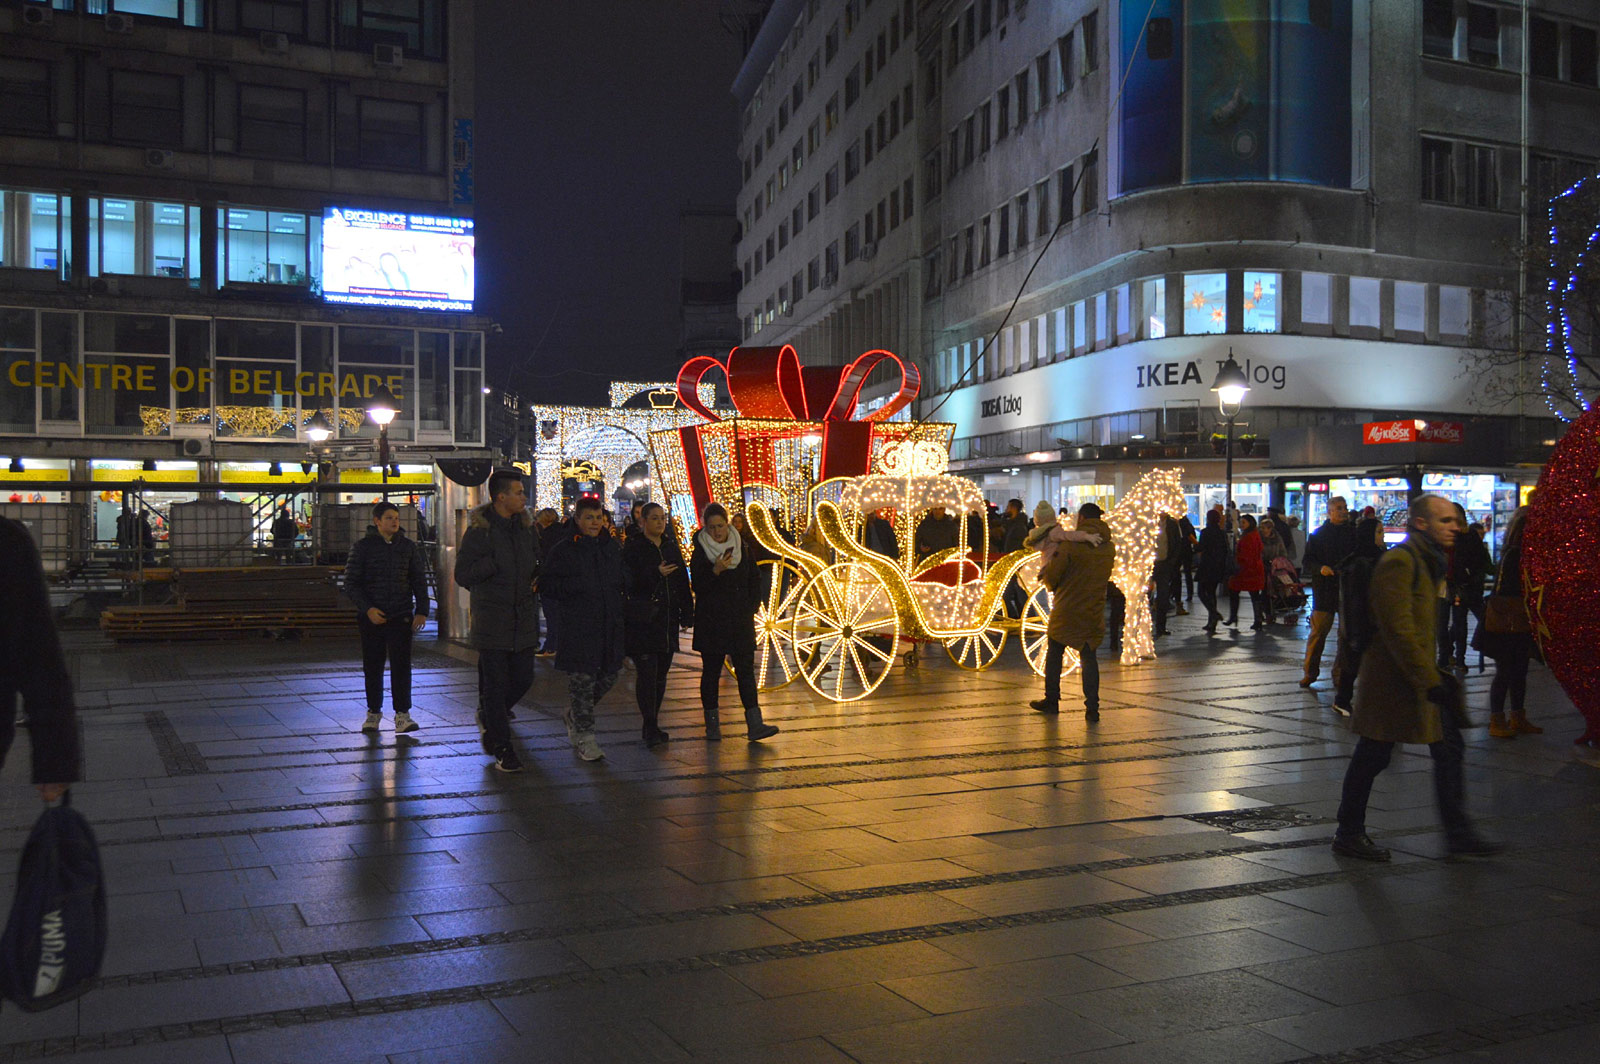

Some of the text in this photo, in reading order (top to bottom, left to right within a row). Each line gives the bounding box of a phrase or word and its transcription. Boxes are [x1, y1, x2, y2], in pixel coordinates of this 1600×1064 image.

[345, 210, 407, 225] EXCELLENCE
[8, 360, 405, 400] CENTRE OF BELGRADE
[1136, 361, 1203, 388] IKEA
[981, 394, 1022, 418] IKEA Izlog
[1383, 422, 1410, 440] KIOSK
[41, 910, 66, 964] PUMA
